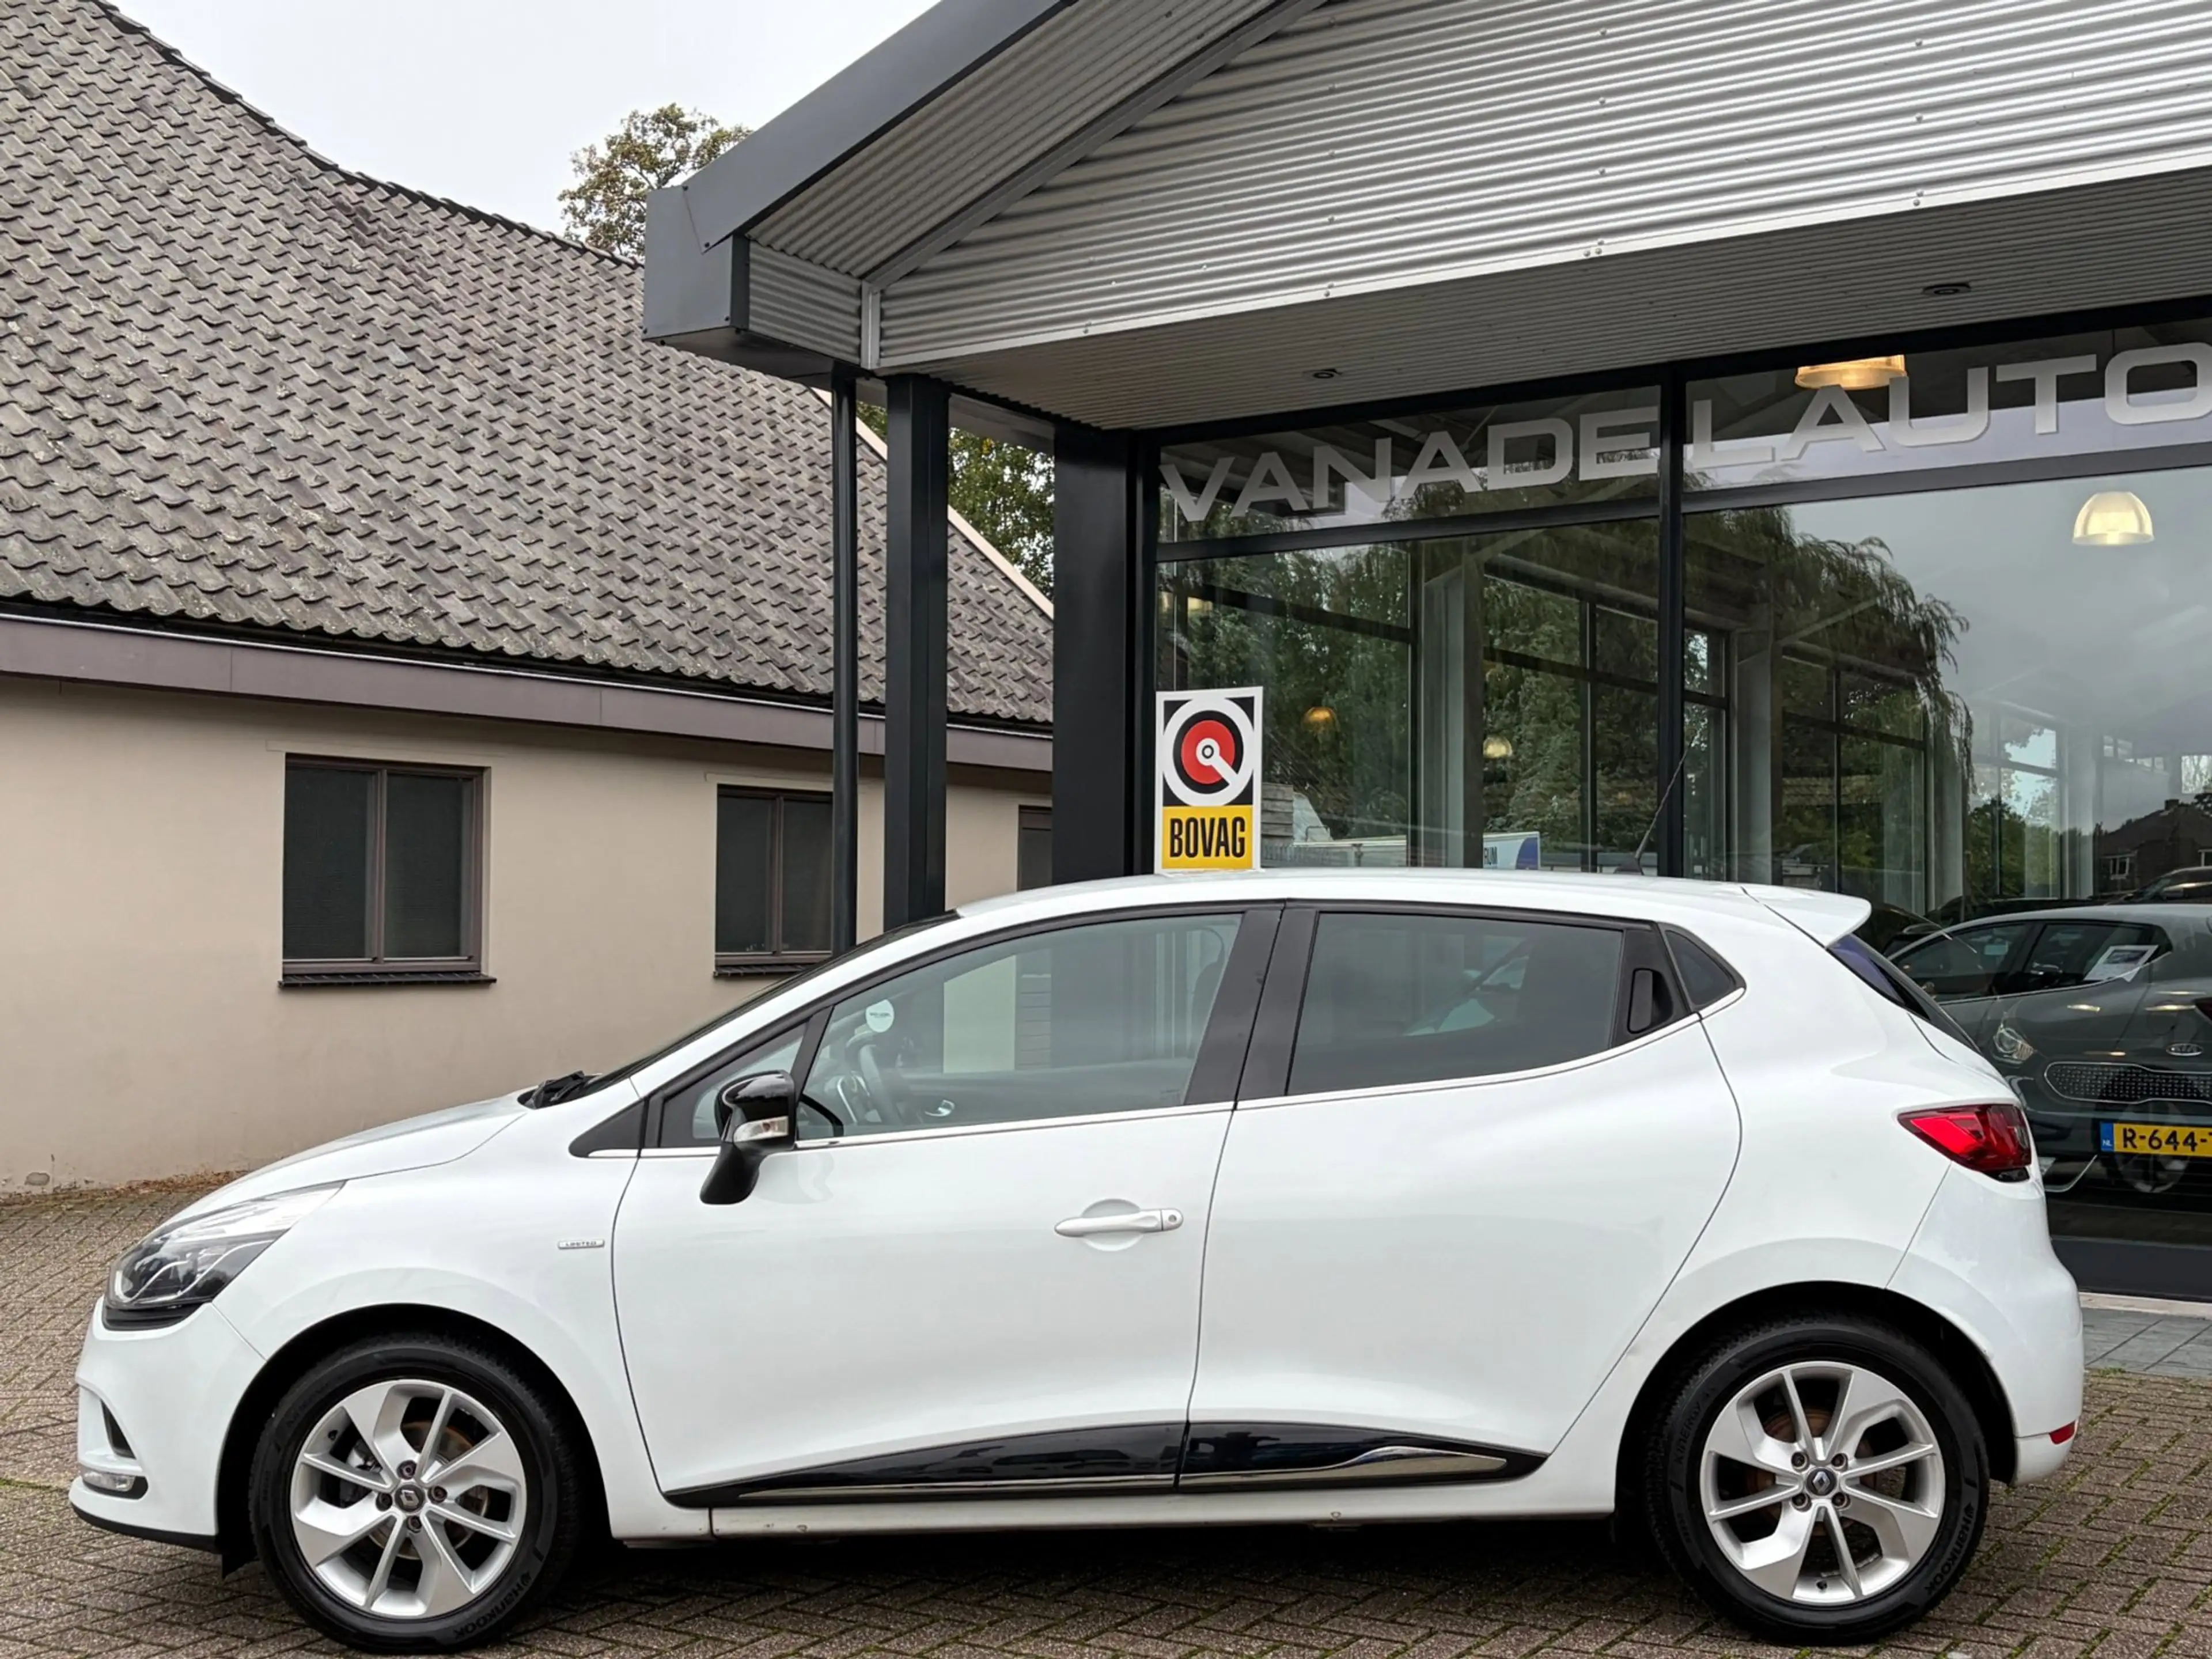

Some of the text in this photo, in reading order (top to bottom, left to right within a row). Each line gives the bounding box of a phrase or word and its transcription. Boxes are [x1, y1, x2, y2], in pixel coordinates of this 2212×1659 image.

[1170, 816, 1245, 858] BOVAG
[2103, 1138, 2112, 1147] NL
[2123, 1127, 2212, 1152] R-644-
